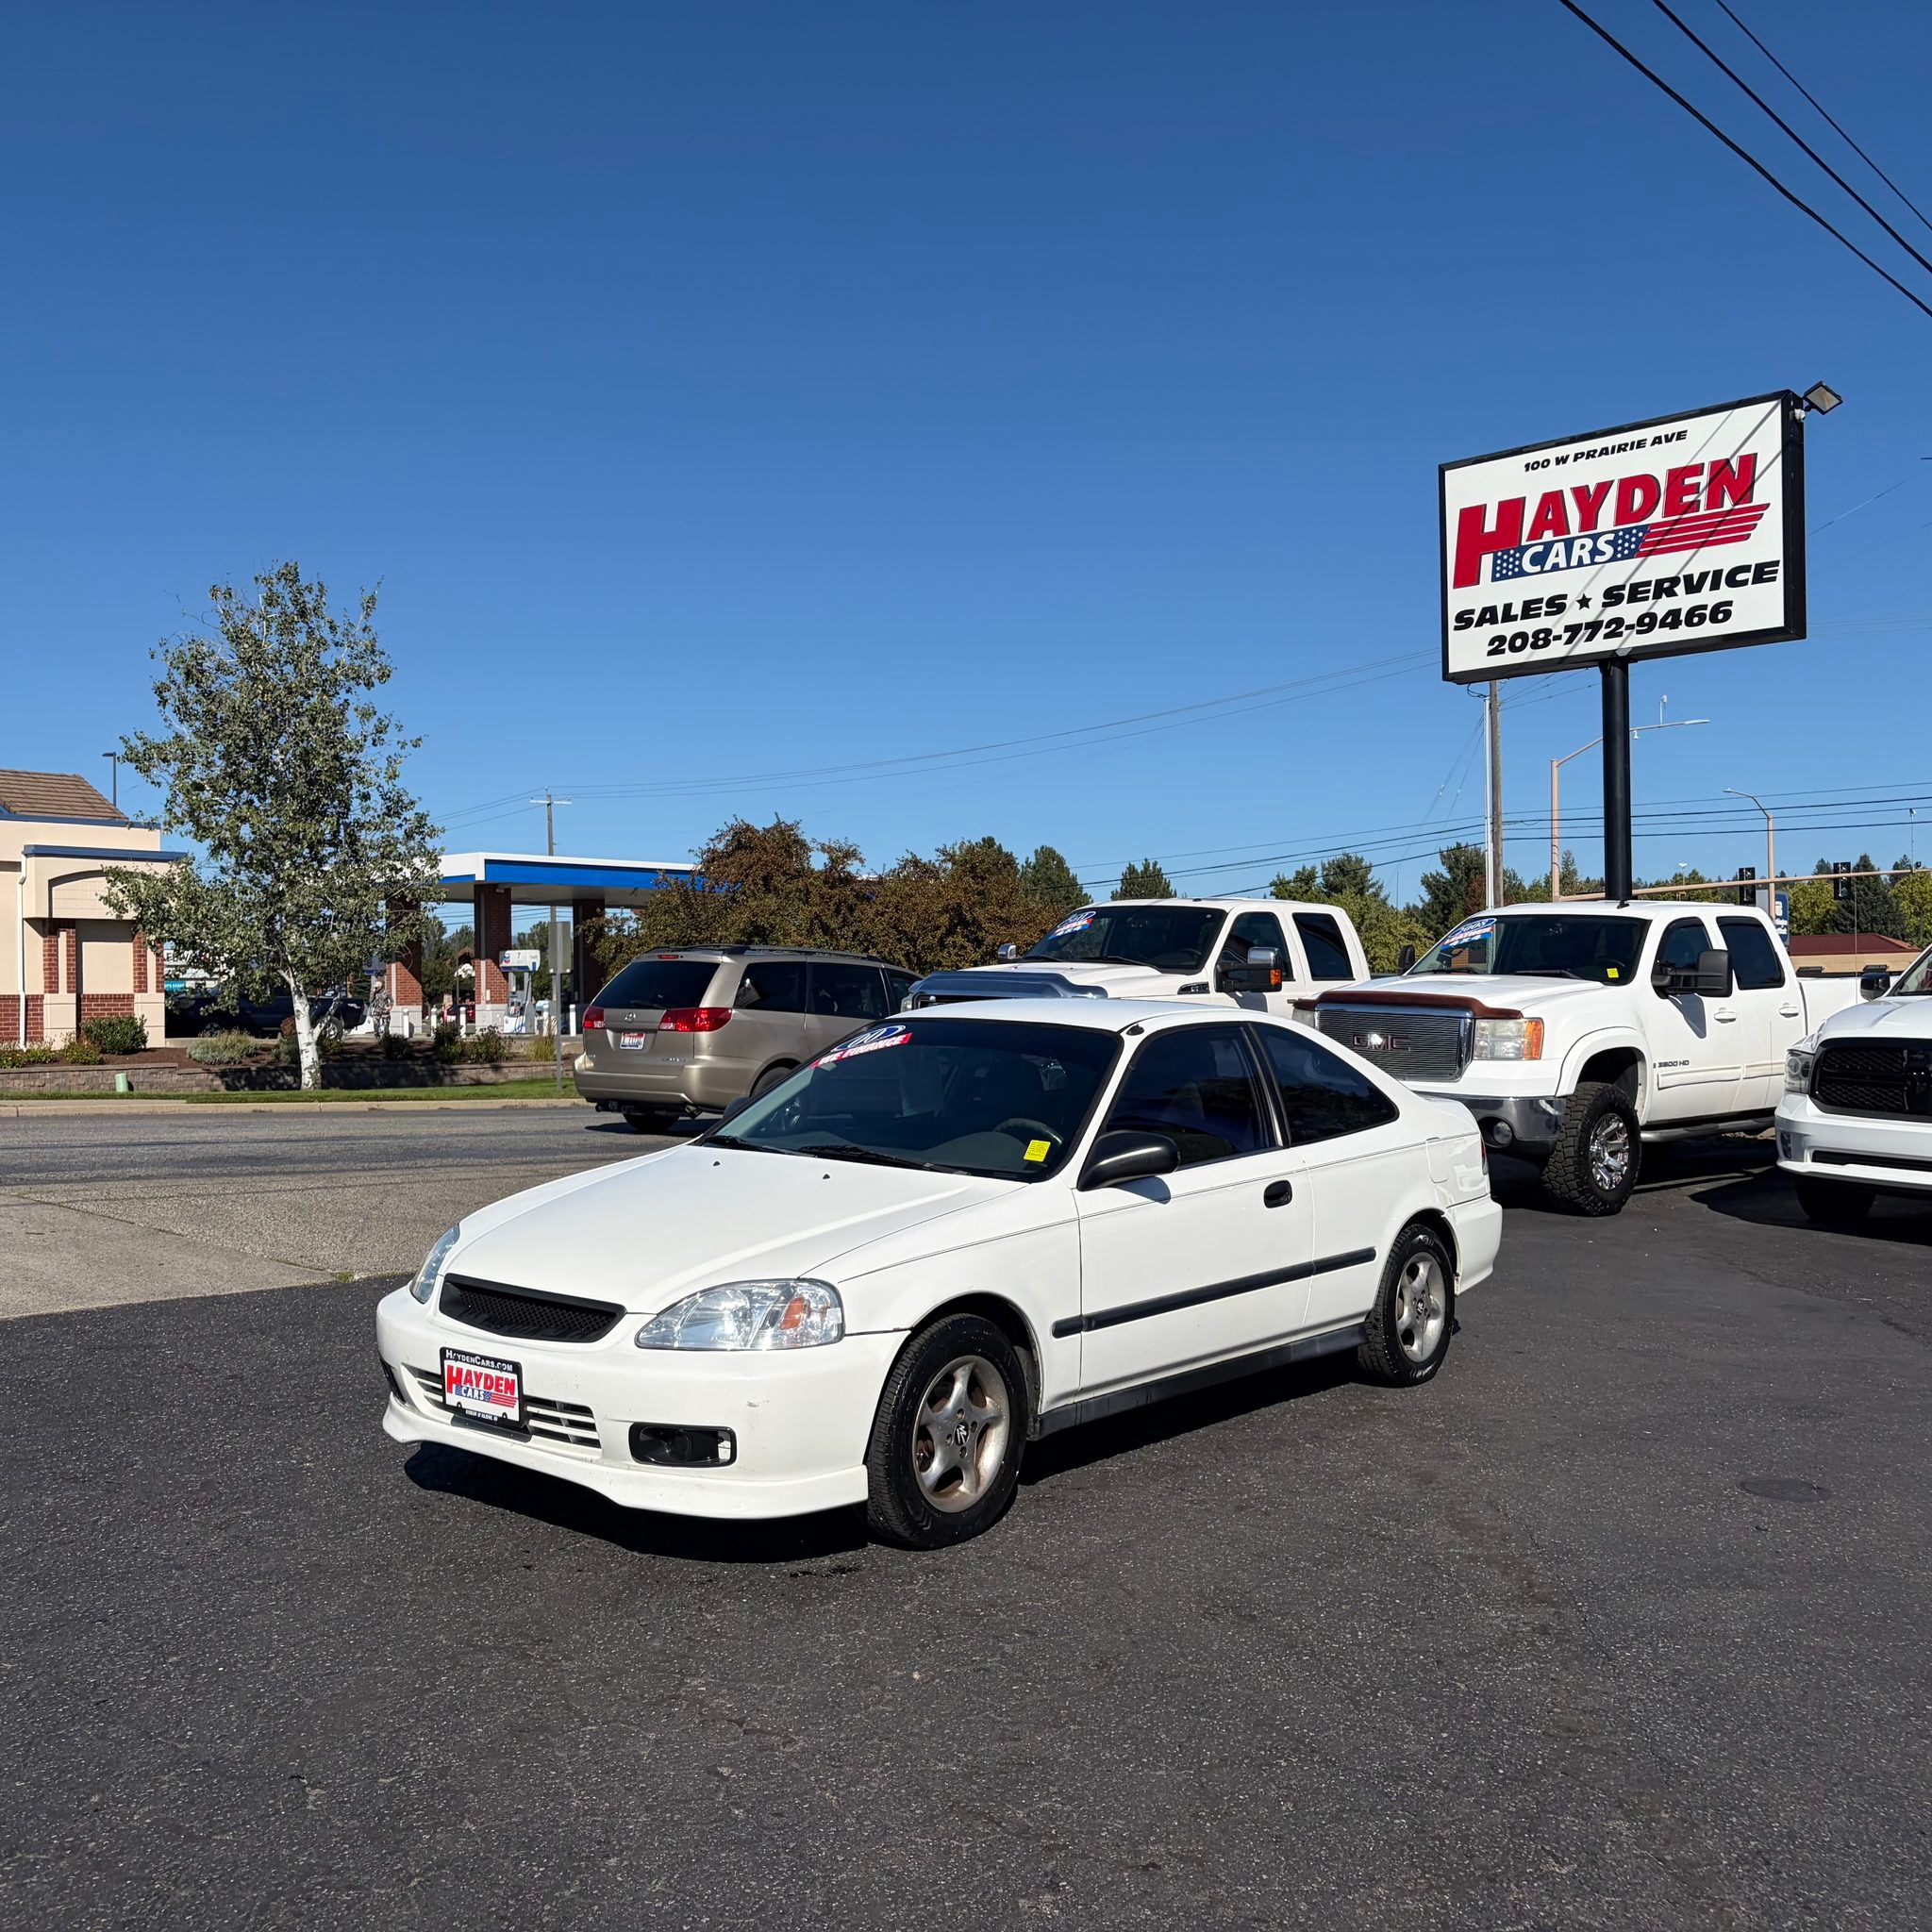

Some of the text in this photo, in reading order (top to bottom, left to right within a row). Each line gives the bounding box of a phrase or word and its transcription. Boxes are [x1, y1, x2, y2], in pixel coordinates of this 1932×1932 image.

[1524, 429, 1689, 473] 100 W PRAIRIE AVE
[1453, 453, 1758, 590] HAYDEN
[1521, 532, 1616, 575] CARS
[1453, 560, 1781, 631] SALES SERVICE
[1487, 600, 1734, 657] 208-772-9466
[446, 1364, 516, 1396] HAYDEN
[461, 1386, 485, 1401] CARS
